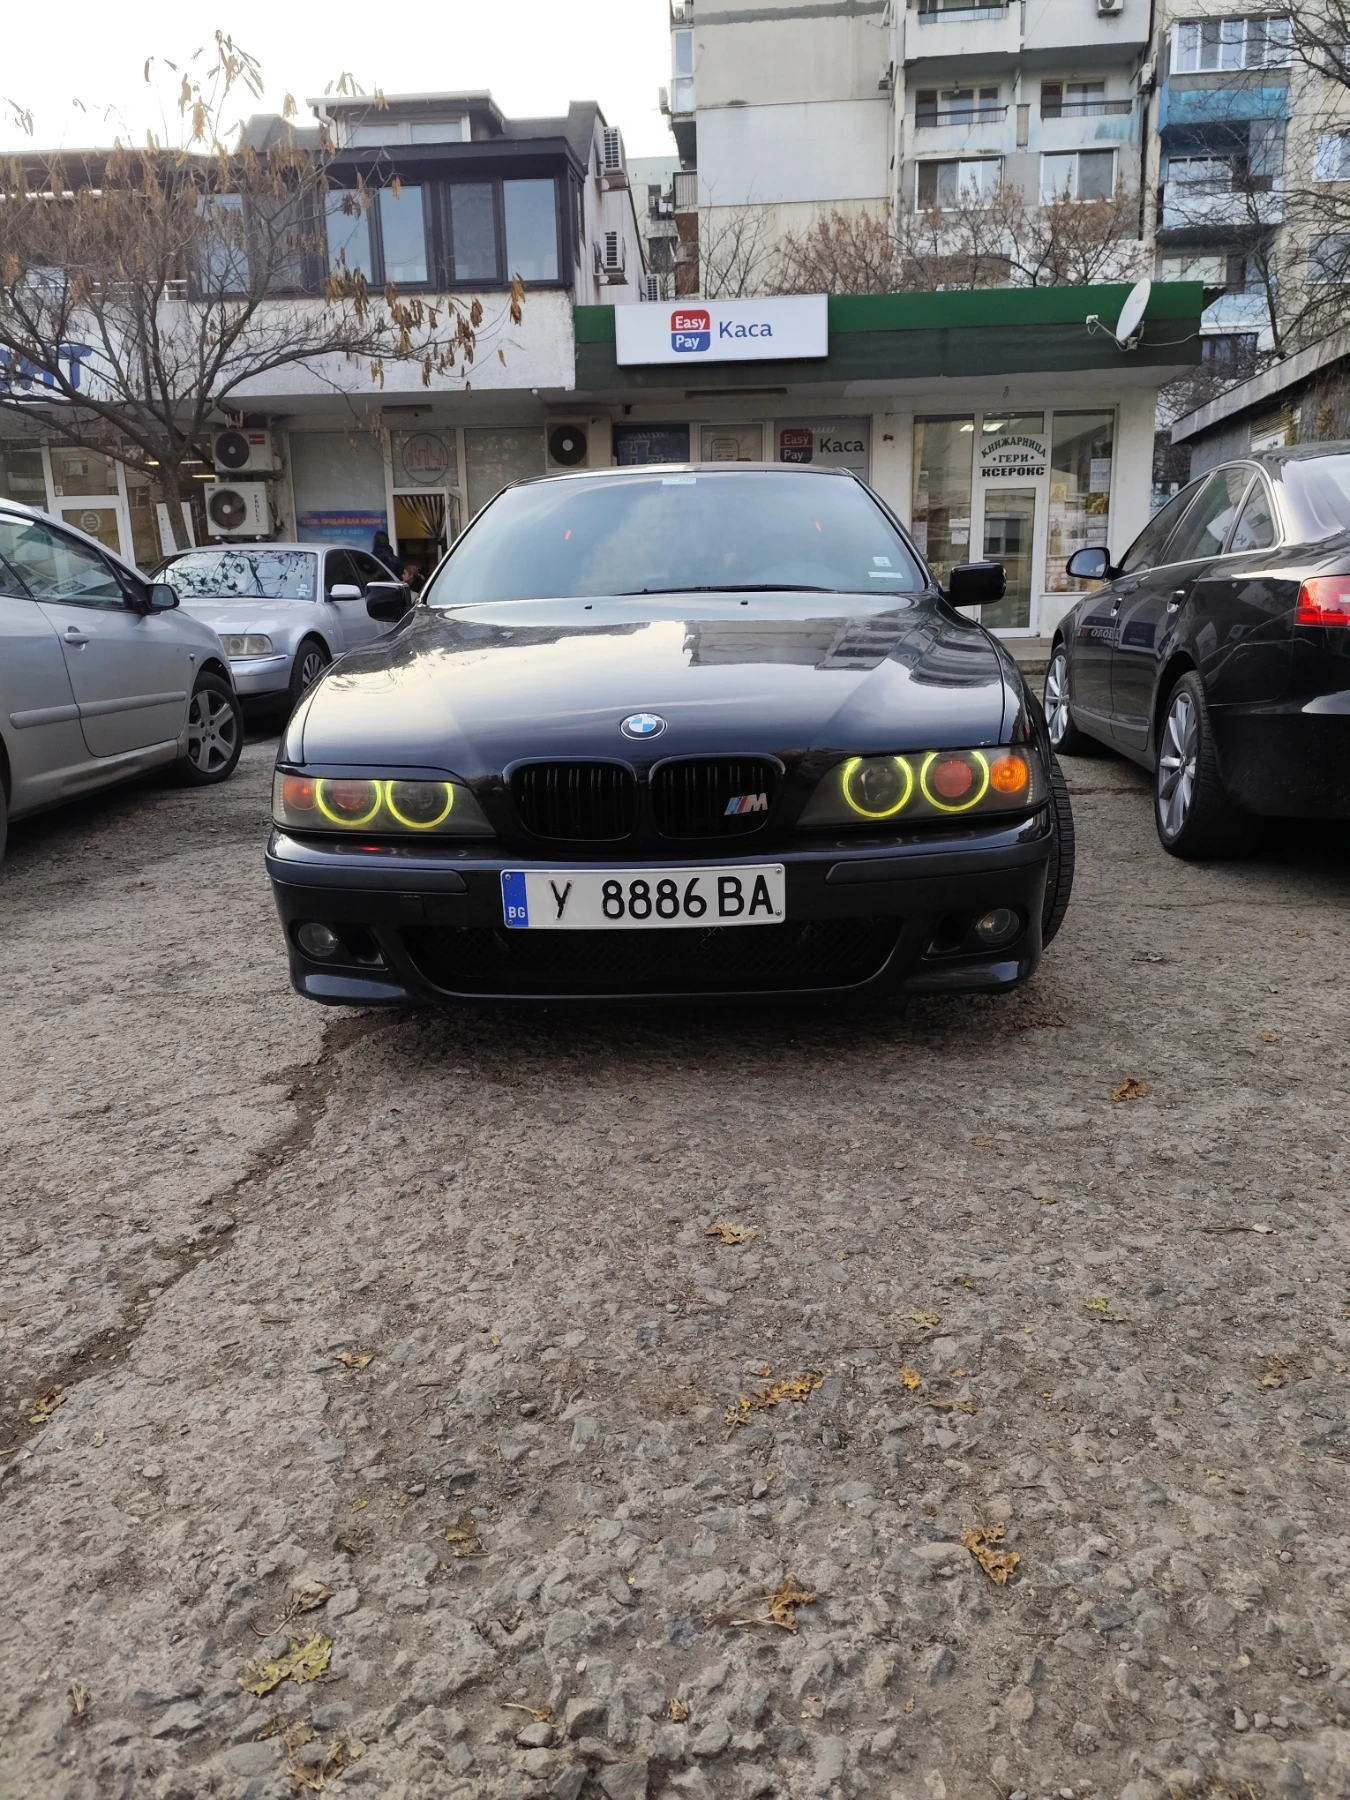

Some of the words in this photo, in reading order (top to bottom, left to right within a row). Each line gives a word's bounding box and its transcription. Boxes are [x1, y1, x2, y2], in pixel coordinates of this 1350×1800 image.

[675, 315, 706, 330] Easy
[719, 320, 773, 338] Каса
[675, 334, 700, 350] Pay
[784, 433, 809, 446] Easy
[819, 437, 865, 453] Каса
[981, 436, 1046, 458] КНИЖАРНИЦА
[784, 449, 804, 462] Pay
[998, 454, 1029, 463] ГЕРИ
[982, 467, 1045, 477] КСЕРОКС
[602, 877, 707, 920] 8886
[508, 906, 526, 919] BG
